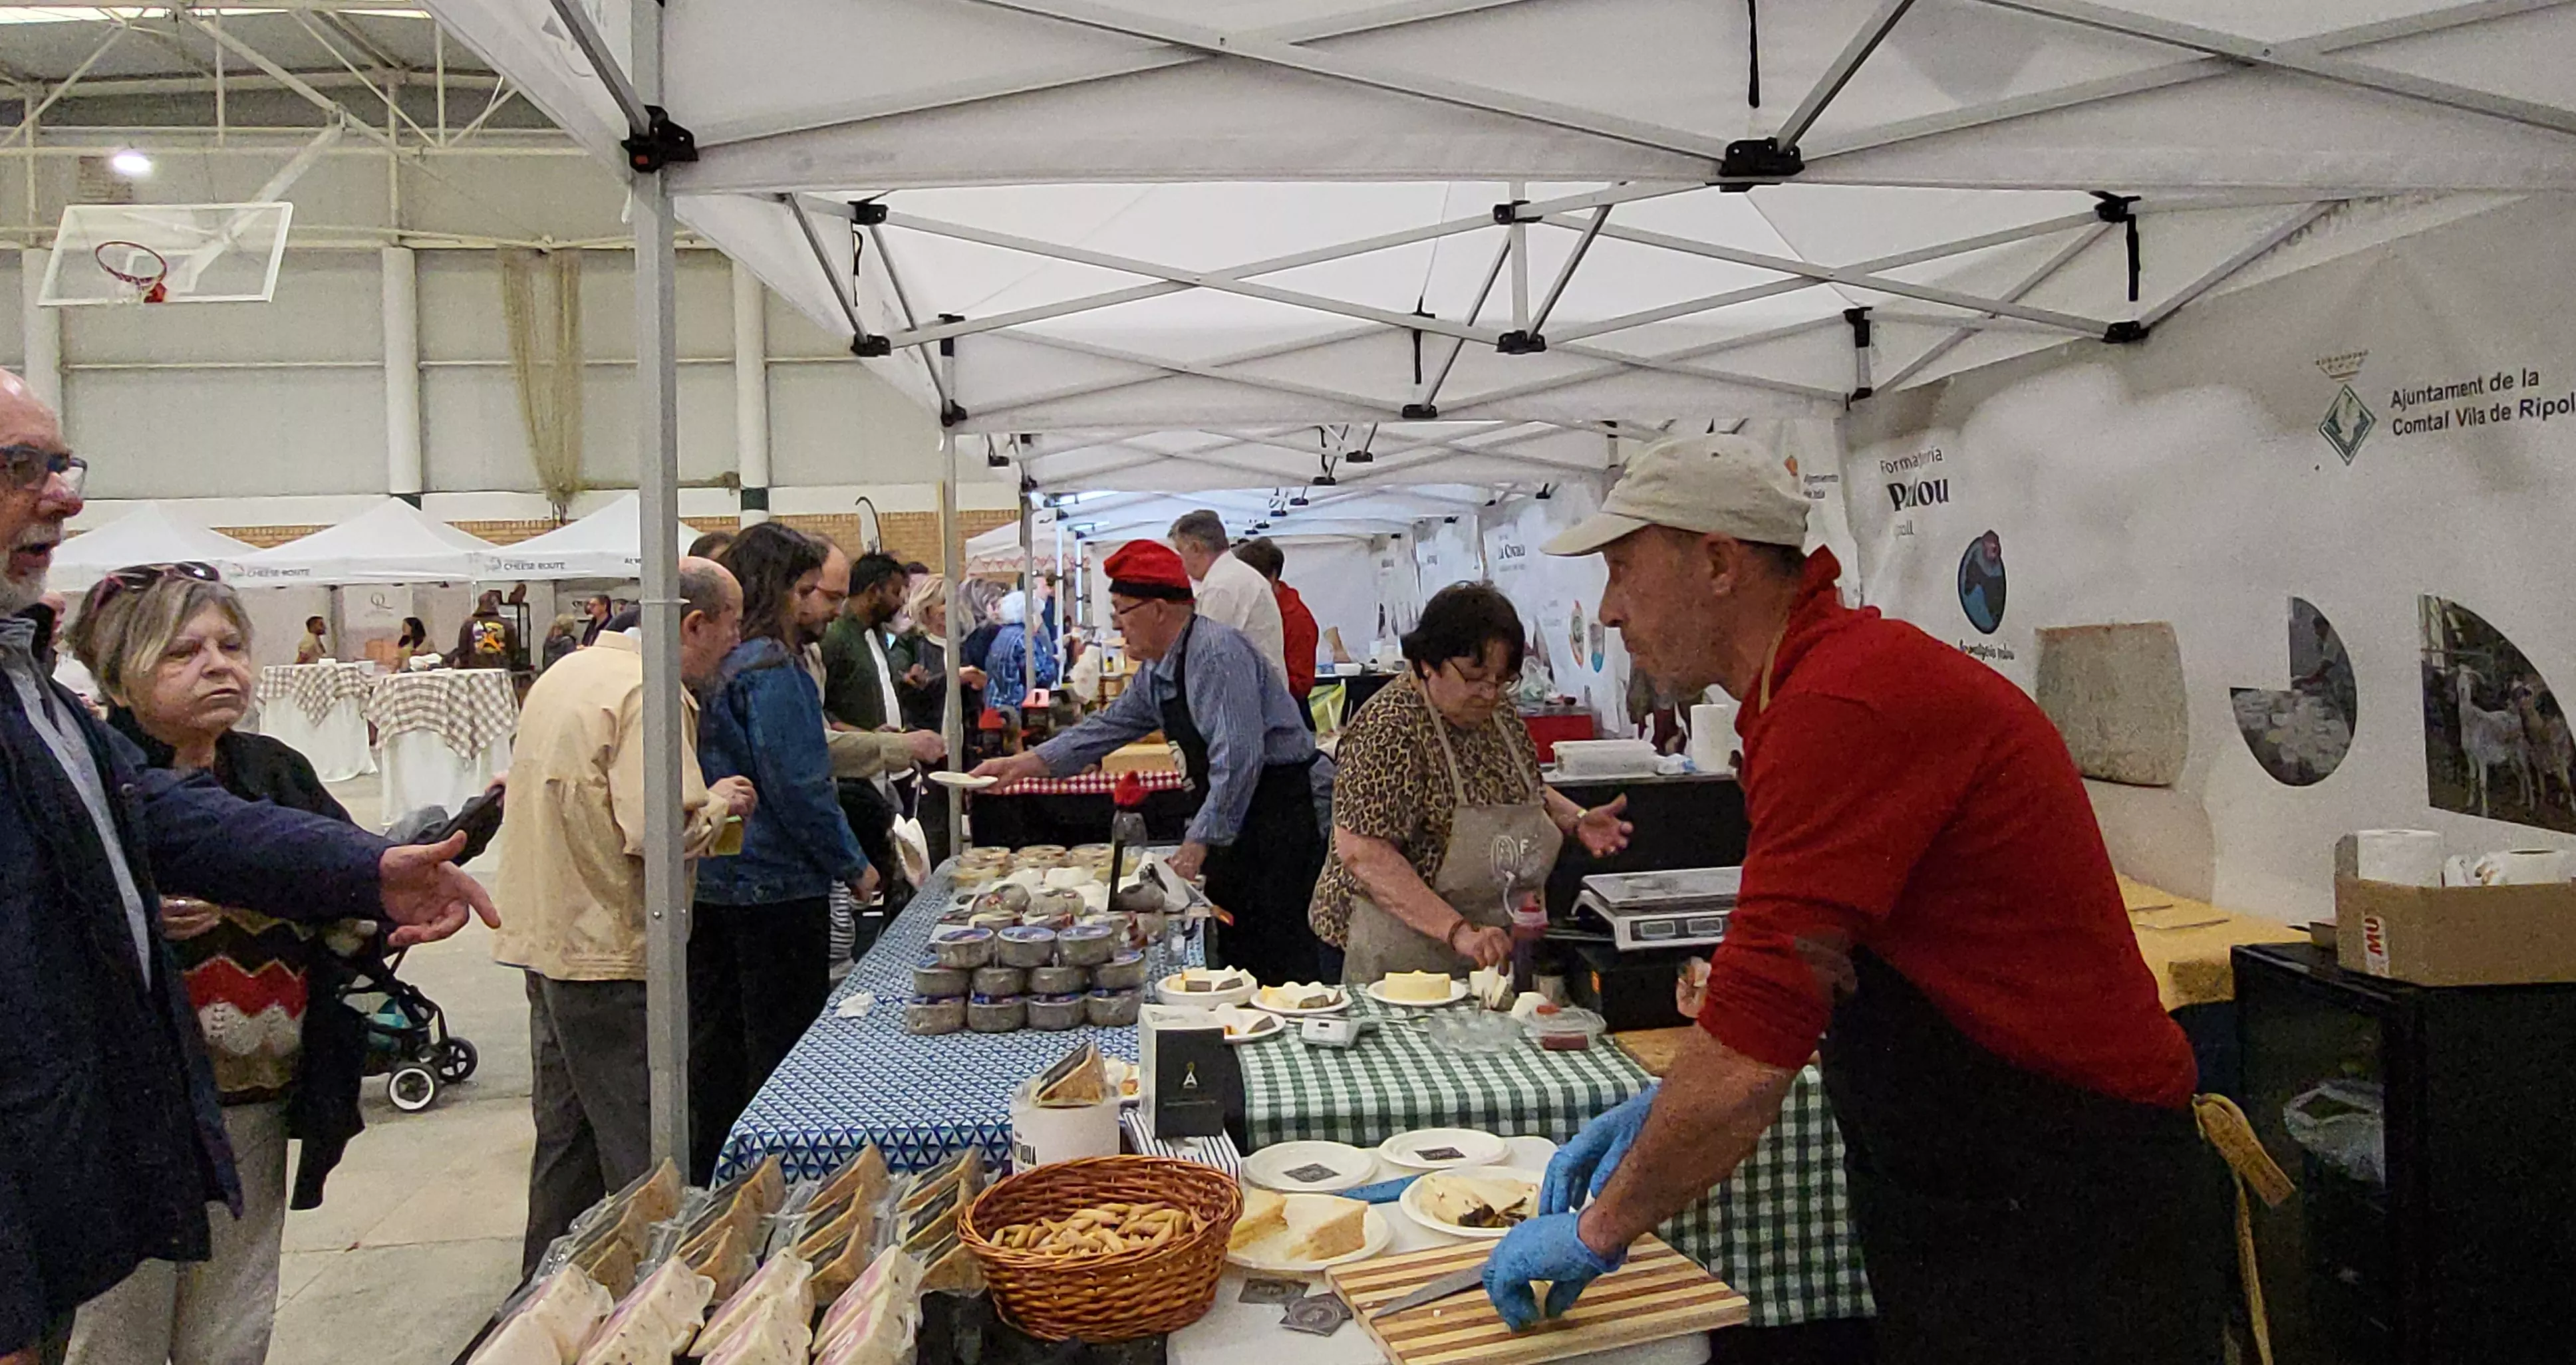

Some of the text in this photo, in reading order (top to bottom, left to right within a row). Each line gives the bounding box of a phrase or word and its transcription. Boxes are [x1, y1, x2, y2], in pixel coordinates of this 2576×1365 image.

[2390, 368, 2539, 412] Ajuntament de la
[2392, 410, 2450, 436] Comtal
[2455, 406, 2486, 428] Vila
[2490, 402, 2511, 423] de
